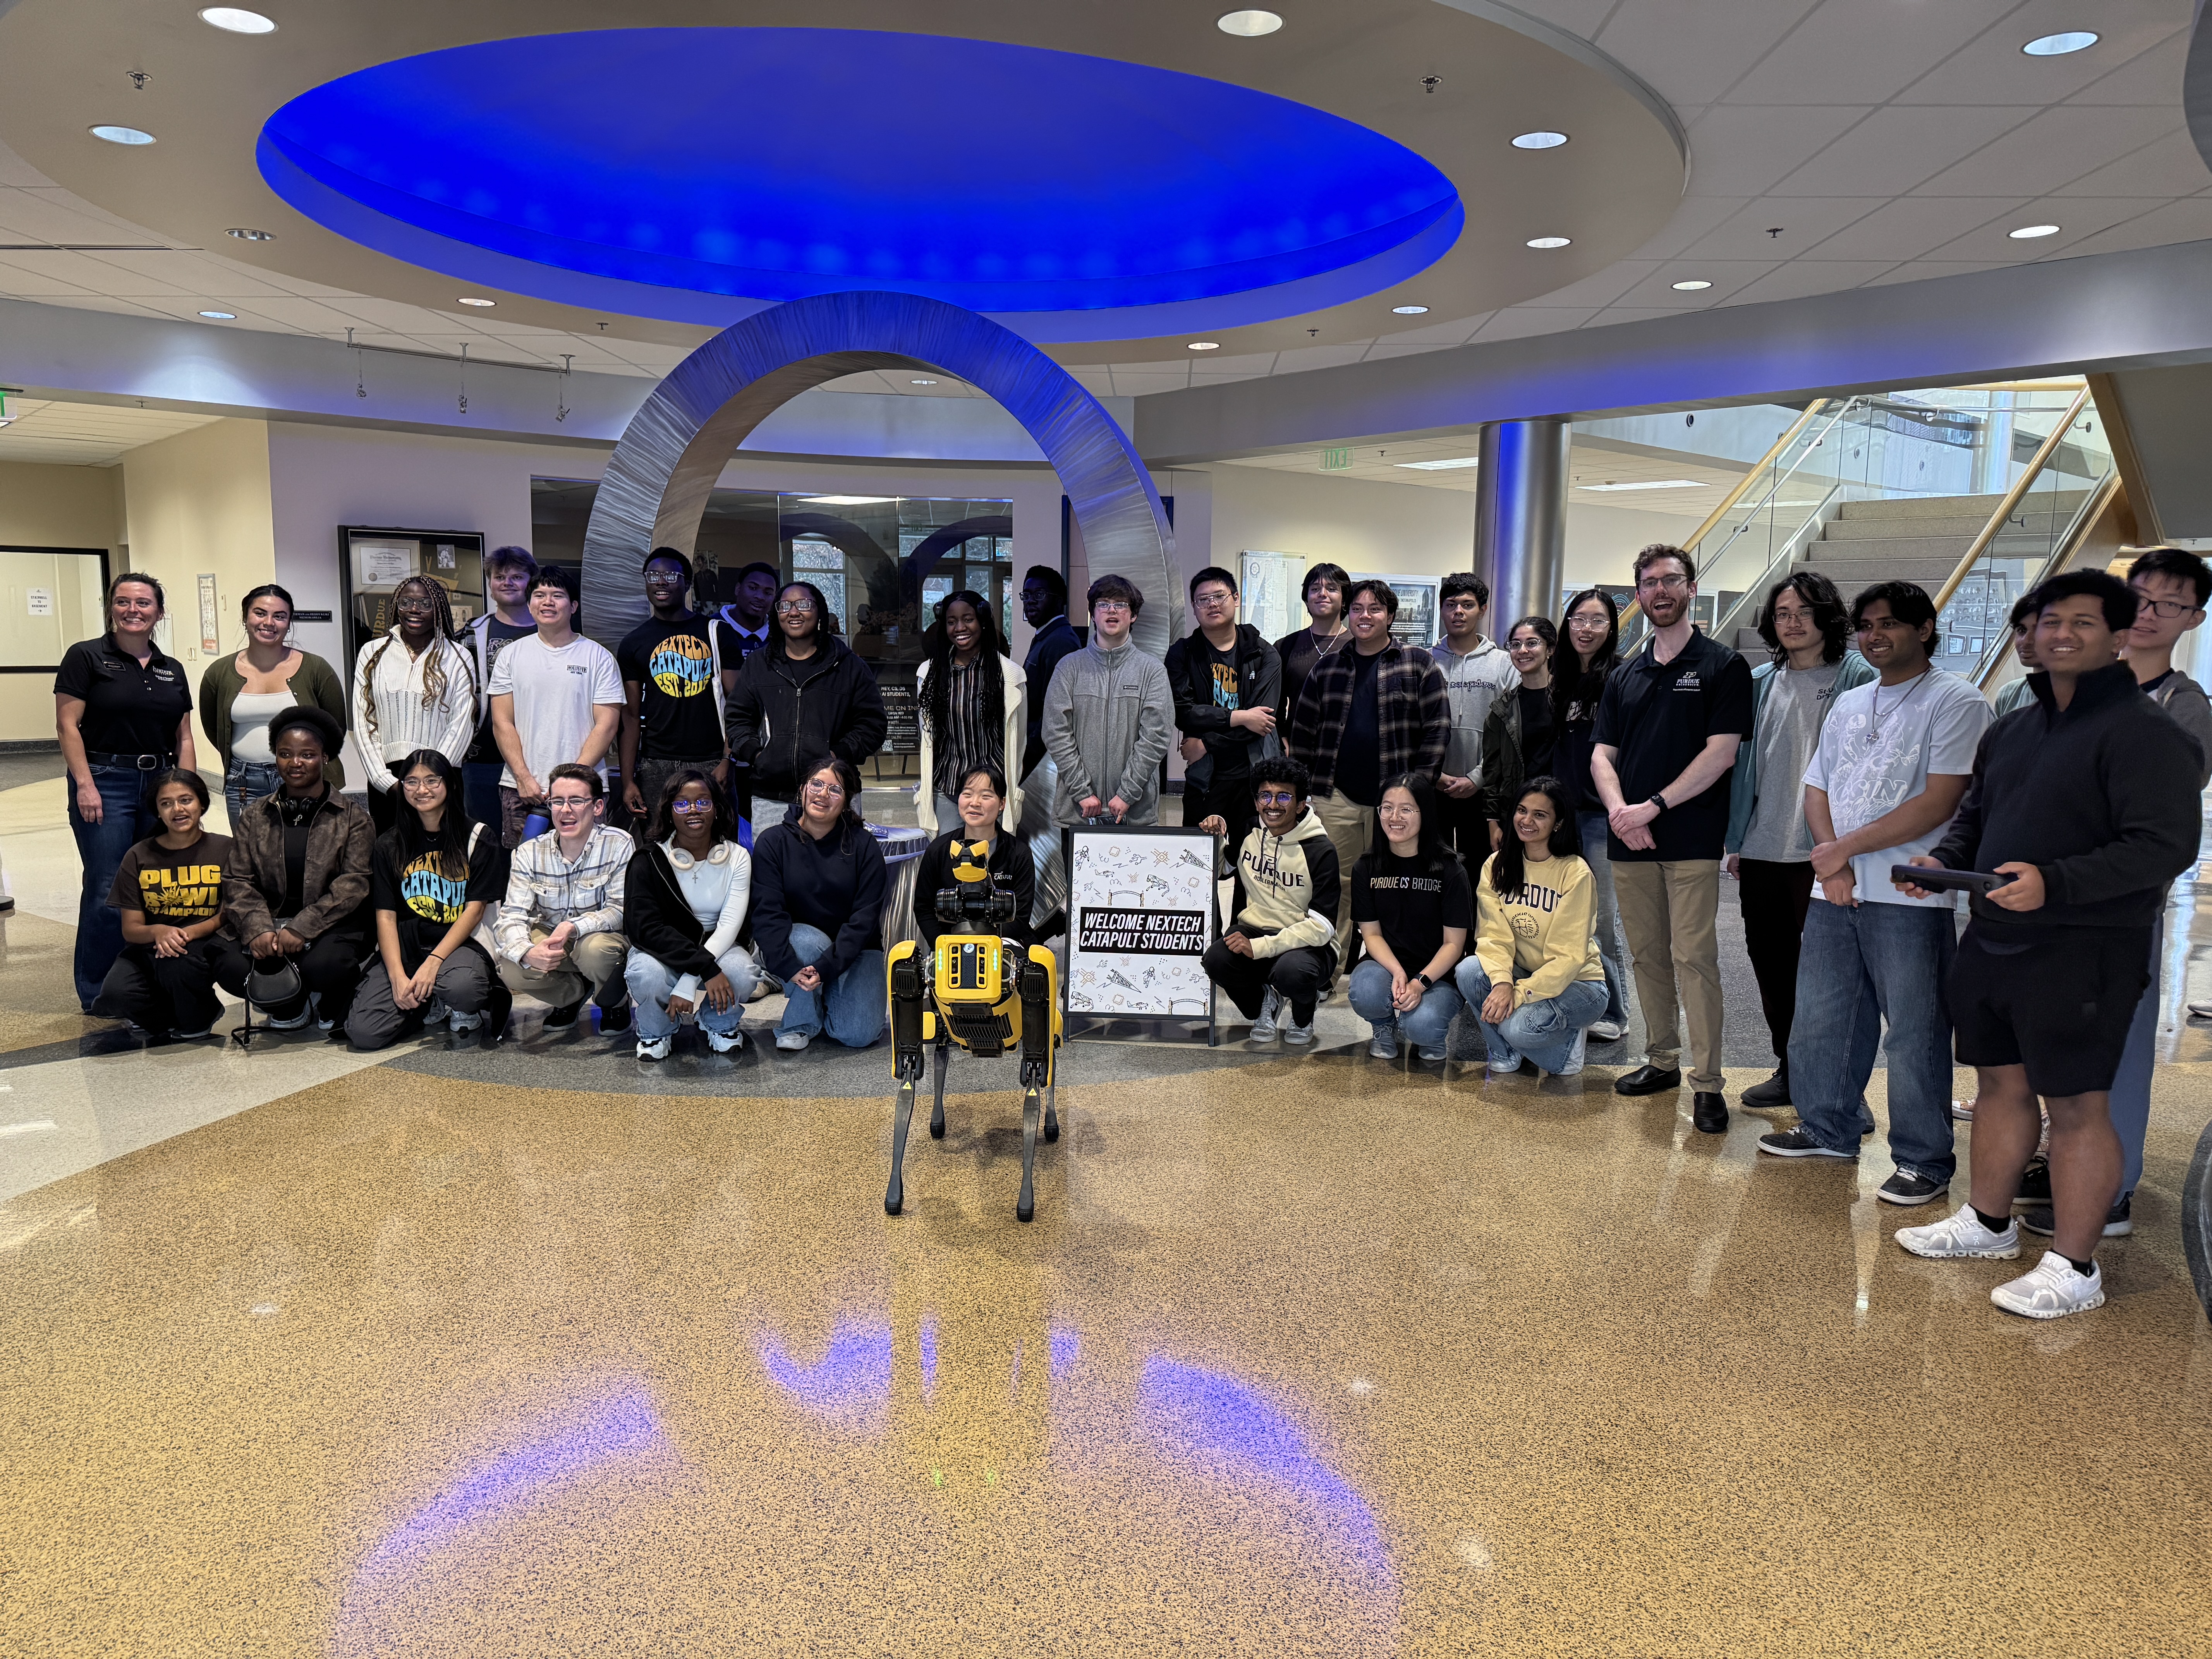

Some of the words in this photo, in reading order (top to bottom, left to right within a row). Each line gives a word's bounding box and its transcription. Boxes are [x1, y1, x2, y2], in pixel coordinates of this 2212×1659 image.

[372, 599, 385, 637] URDUE
[650, 635, 711, 660] NEXTECH
[649, 650, 712, 682] CATAPULT
[654, 672, 682, 697] EST.
[1187, 854, 1205, 868] PURDUE
[139, 865, 222, 889] PLUG
[401, 870, 467, 907] CATAPUL
[1370, 877, 1399, 888] PURDUE
[1400, 877, 1410, 888] CS
[1412, 878, 1442, 892] BRIDGE
[1499, 883, 1562, 913] URDU
[1085, 913, 1145, 930] WELCOME
[1145, 915, 1202, 932] NEXTECH
[1080, 931, 1141, 948] CATAPULT
[1140, 933, 1204, 951] STUDENTS
[1114, 974, 1132, 988] PURDUE
